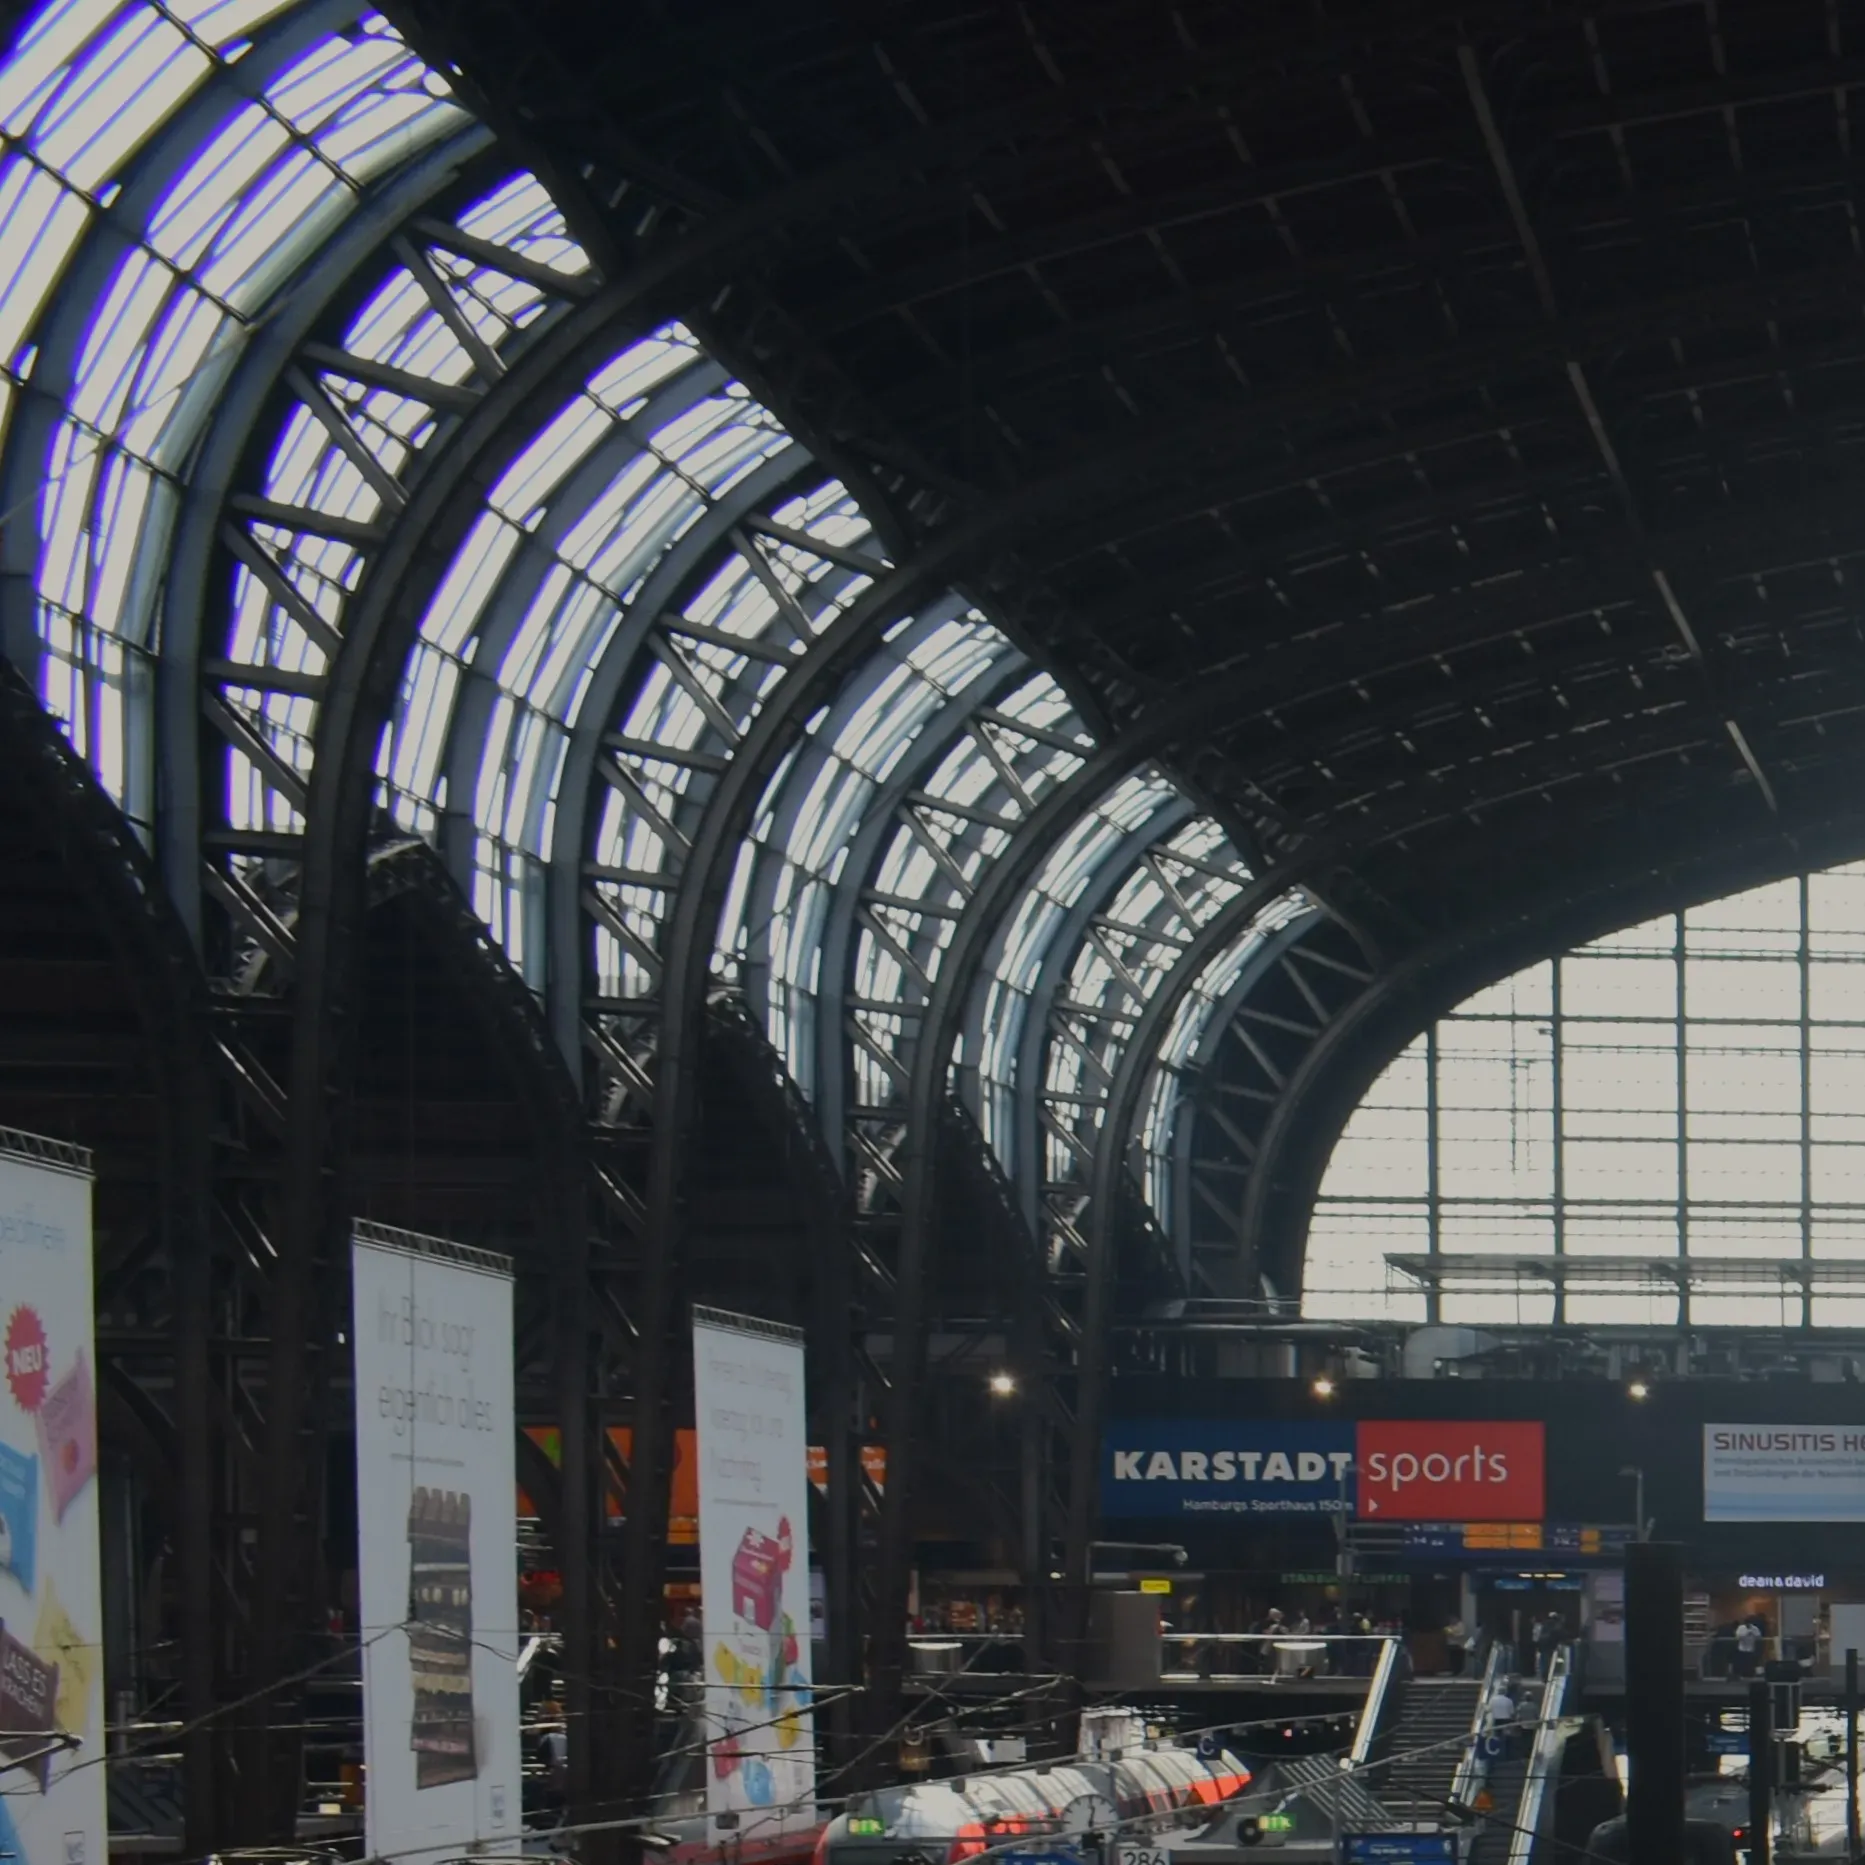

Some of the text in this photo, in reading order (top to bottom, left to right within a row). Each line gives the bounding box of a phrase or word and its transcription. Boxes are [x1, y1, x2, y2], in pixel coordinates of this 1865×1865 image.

[13, 1344, 42, 1376] NEU
[1713, 1431, 1836, 1452] SINUSITIS
[1112, 1444, 1509, 1492] KARSTADT sports
[1199, 1736, 1214, 1756] C
[1484, 1736, 1500, 1756] C
